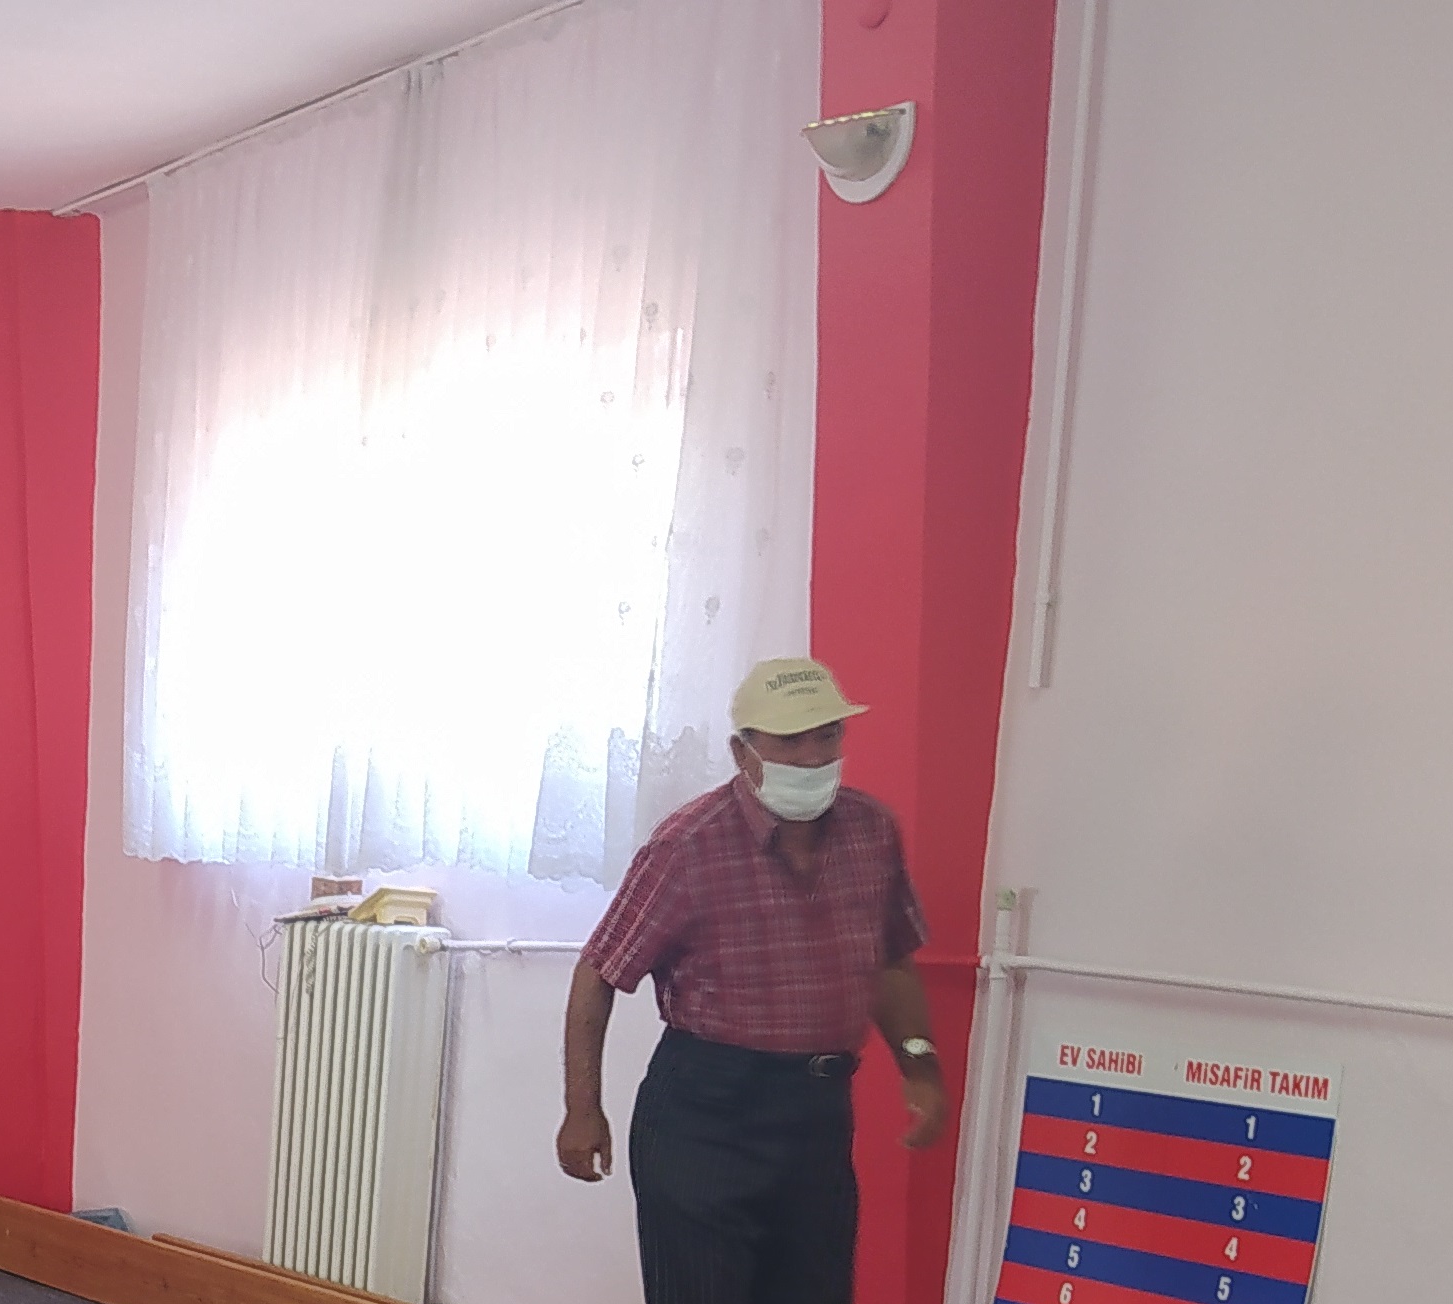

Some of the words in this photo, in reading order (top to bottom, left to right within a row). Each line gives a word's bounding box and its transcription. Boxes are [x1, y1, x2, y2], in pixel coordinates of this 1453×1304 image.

[1058, 1044, 1082, 1067] EV
[1268, 1070, 1331, 1101] TAKIM
[1092, 1093, 1101, 1116] 1
[1245, 1116, 1256, 1139] 1
[1084, 1131, 1097, 1155] 2
[1237, 1155, 1252, 1181] 2
[1079, 1169, 1092, 1193] 3
[1073, 1207, 1086, 1230] 4
[1231, 1196, 1246, 1221] 3
[1067, 1245, 1080, 1268] 5
[1224, 1237, 1238, 1261] 4
[1059, 1282, 1073, 1304] 6
[1217, 1276, 1231, 1301] 5
